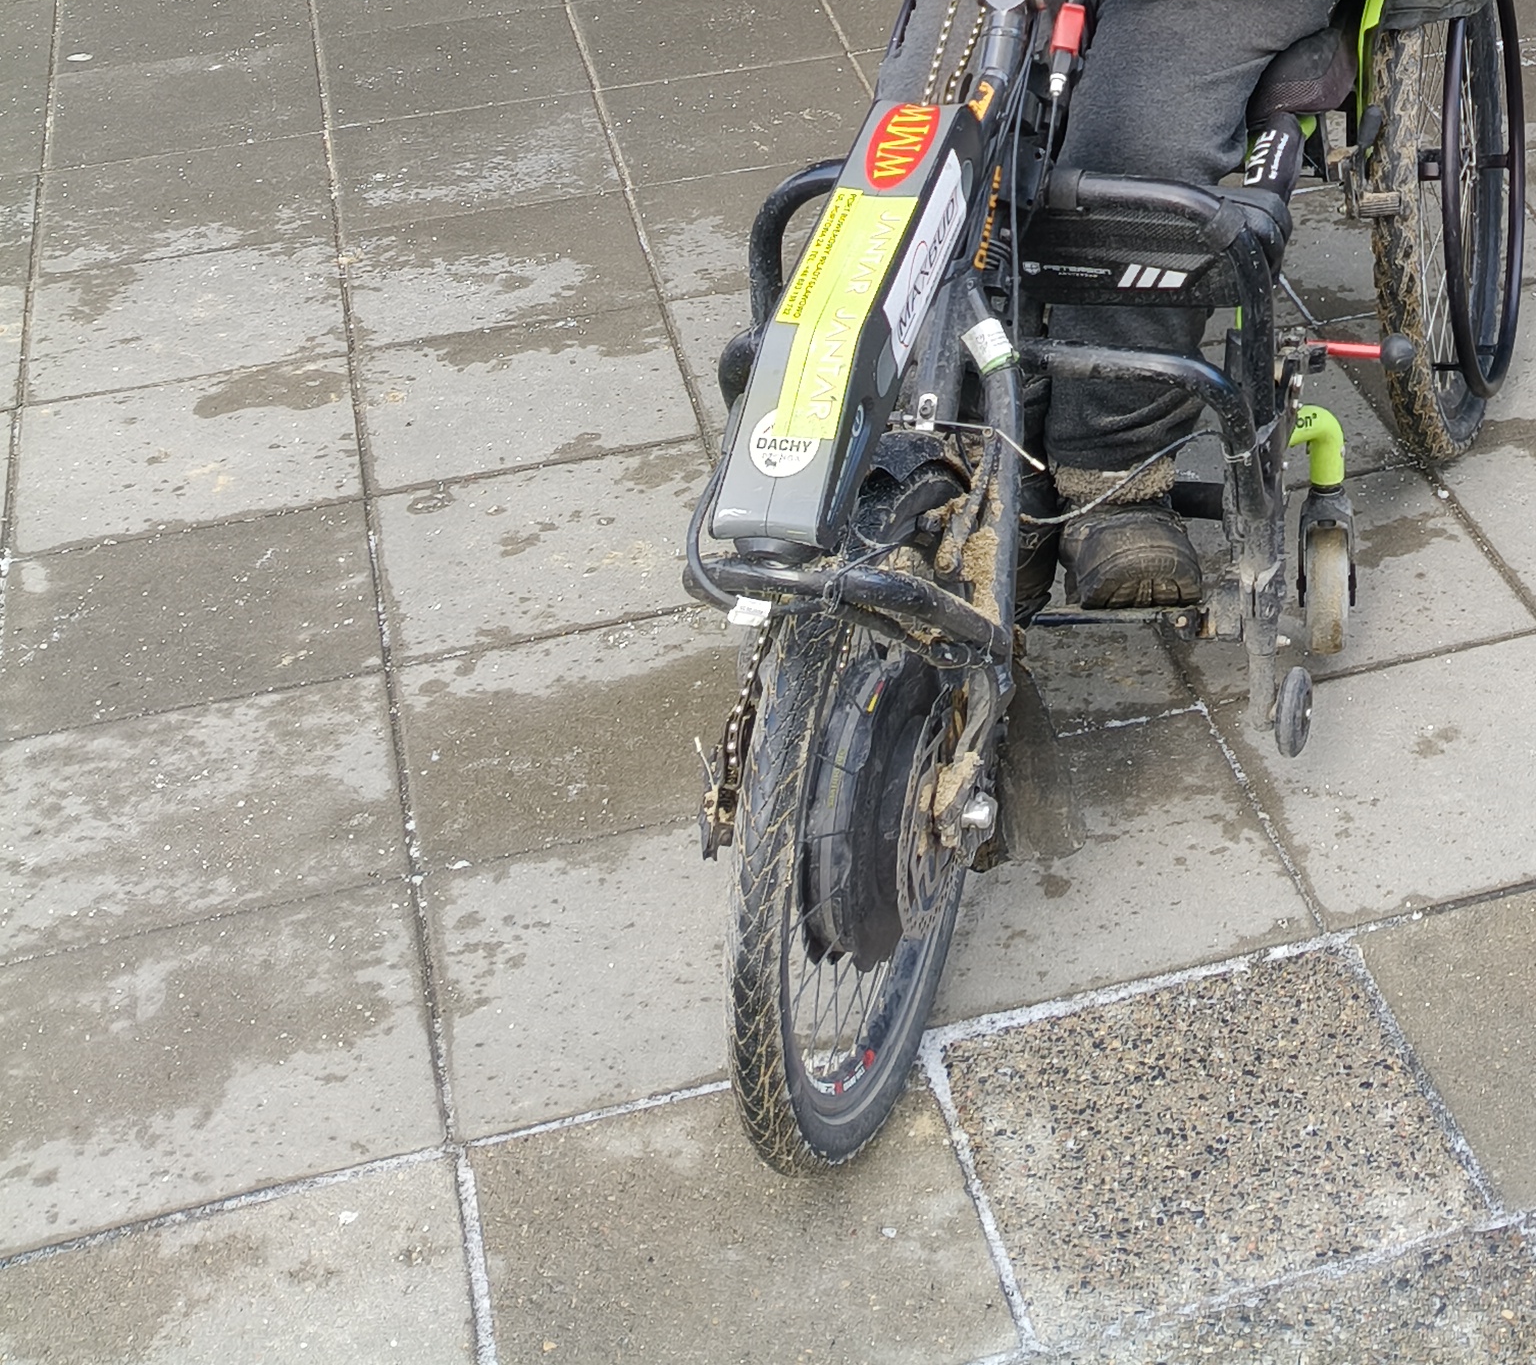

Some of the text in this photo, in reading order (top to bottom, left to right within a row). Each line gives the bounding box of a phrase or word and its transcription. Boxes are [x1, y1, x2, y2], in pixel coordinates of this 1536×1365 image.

[846, 209, 900, 295] JANTAR
[807, 306, 856, 419] JANTAR
[756, 437, 812, 453] DACHY
